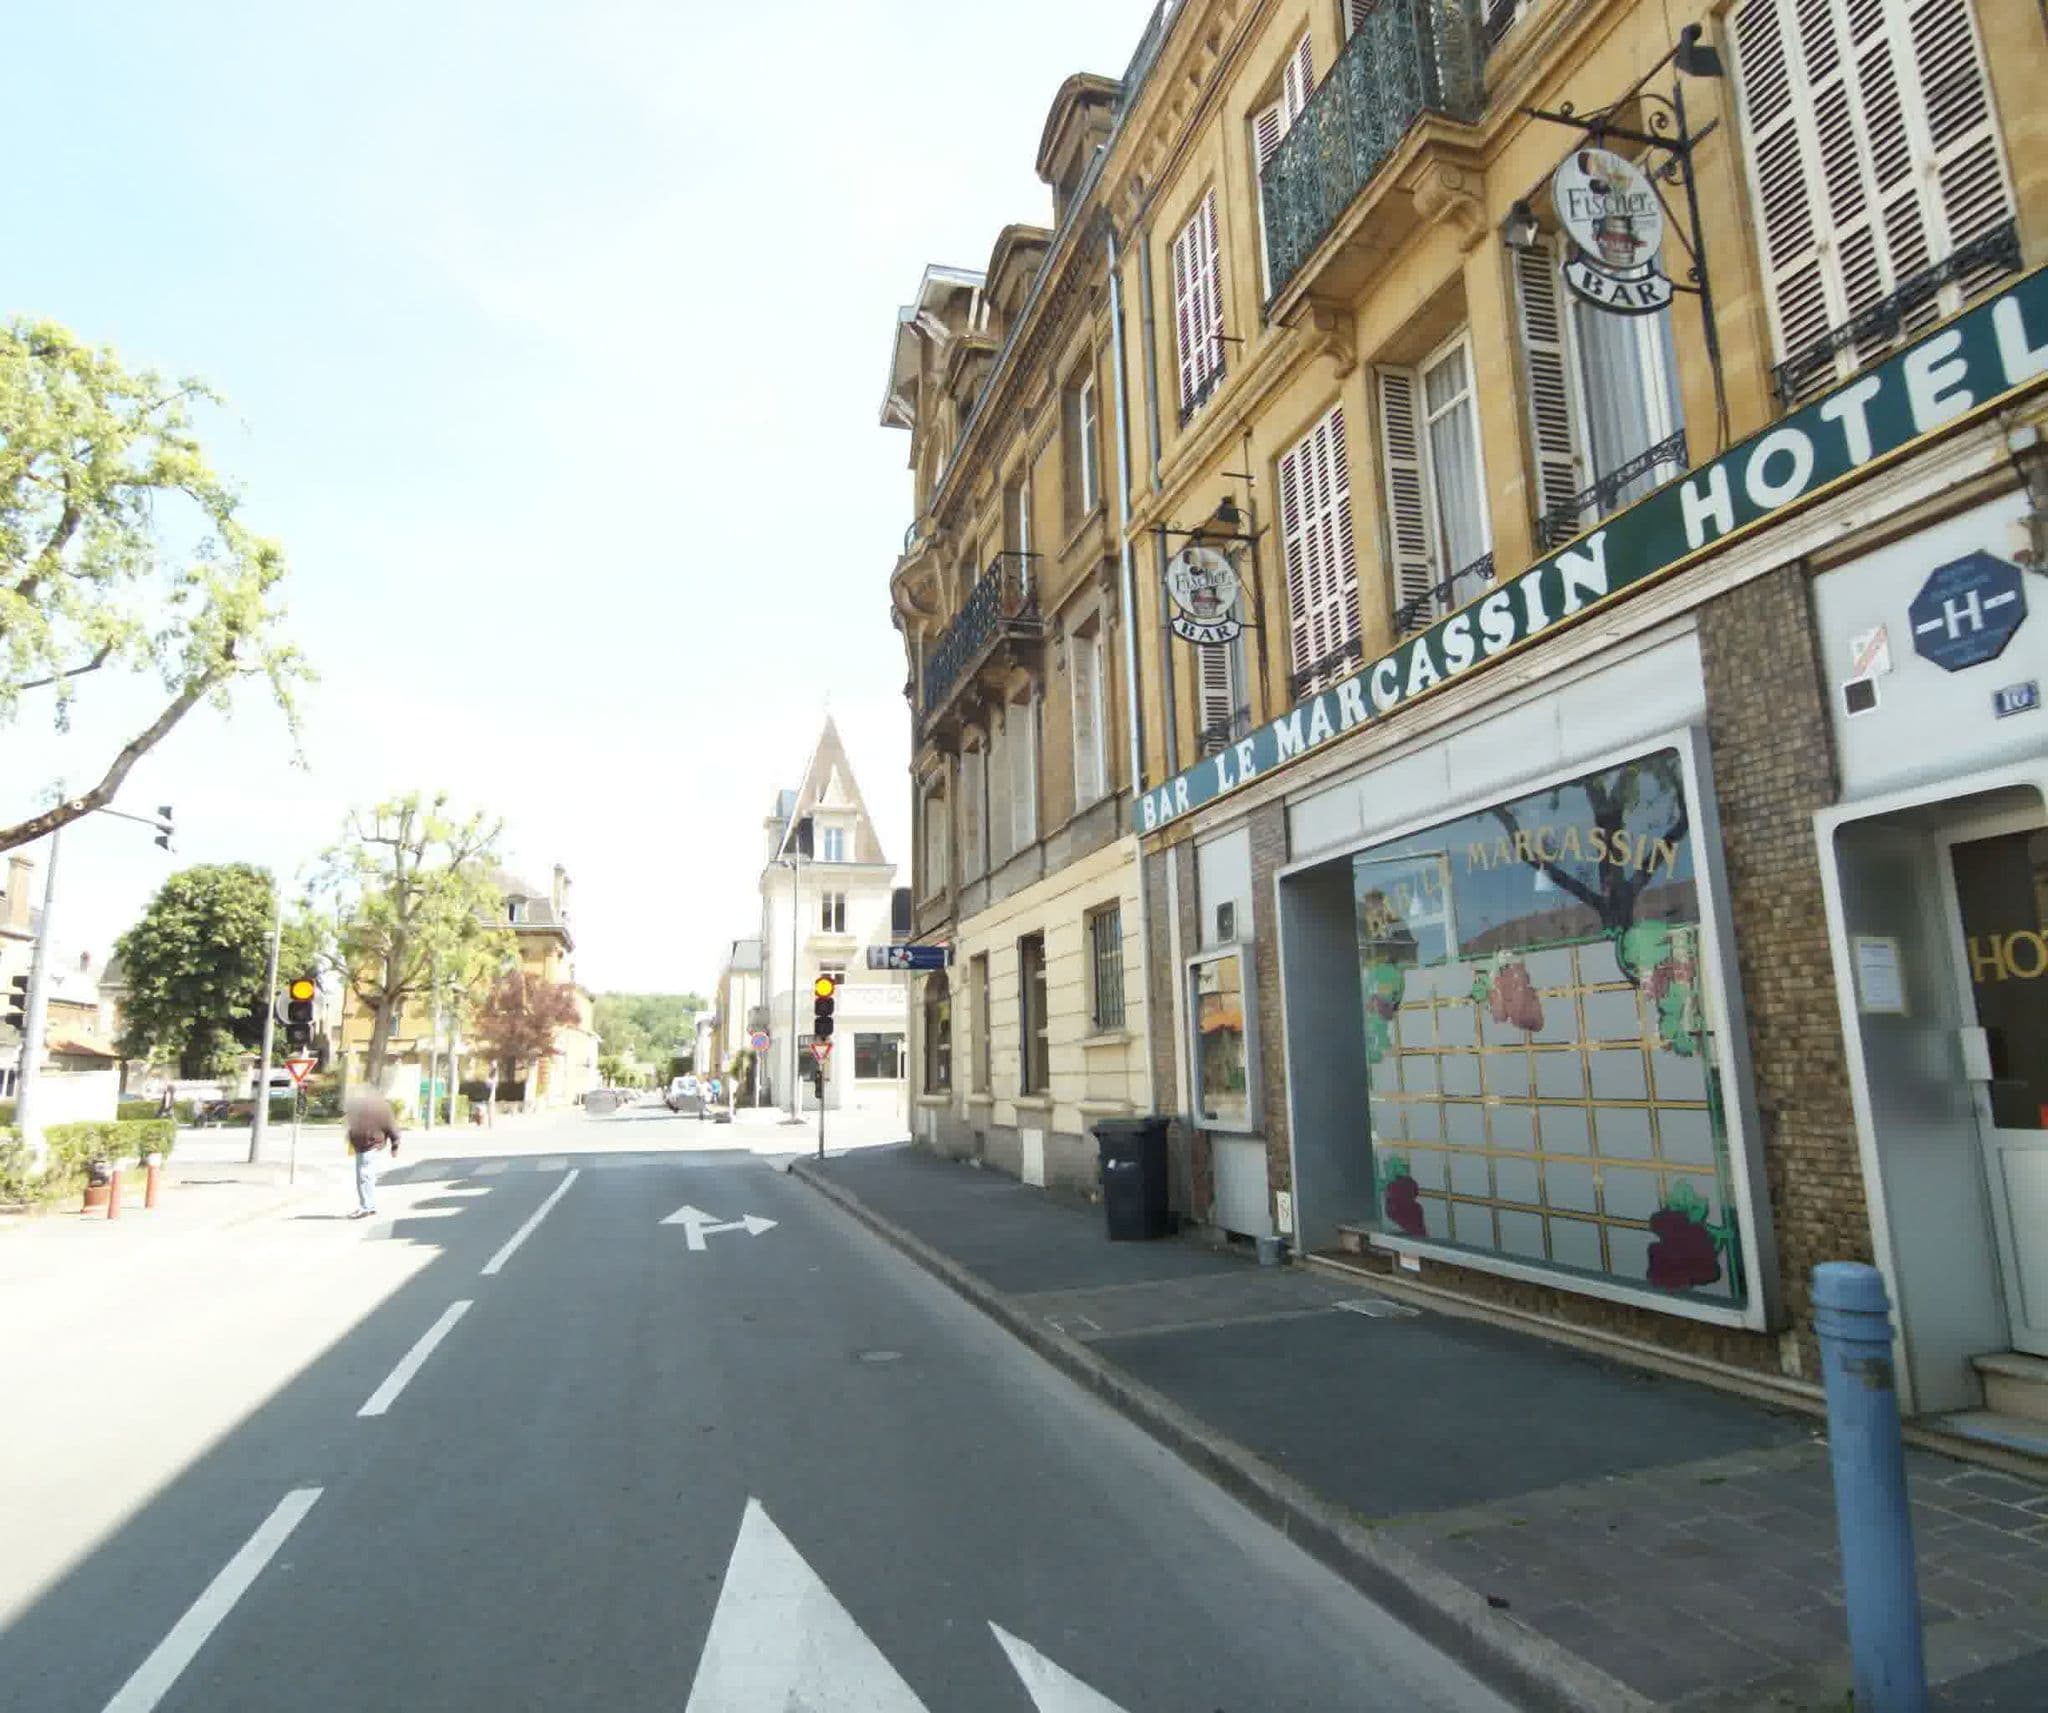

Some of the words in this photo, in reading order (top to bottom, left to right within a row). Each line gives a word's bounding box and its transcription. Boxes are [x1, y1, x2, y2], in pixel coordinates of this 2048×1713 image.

[1567, 184, 1648, 219] Fischer
[1581, 271, 1661, 307] BAR
[1142, 775, 1190, 829] BAR
[1214, 738, 1257, 794] LE
[1272, 530, 1608, 764] MARCASSIN
[1679, 294, 2048, 550] HOTEL
[1180, 621, 1232, 641] BAR
[1467, 823, 1680, 880] MARCASSIN
